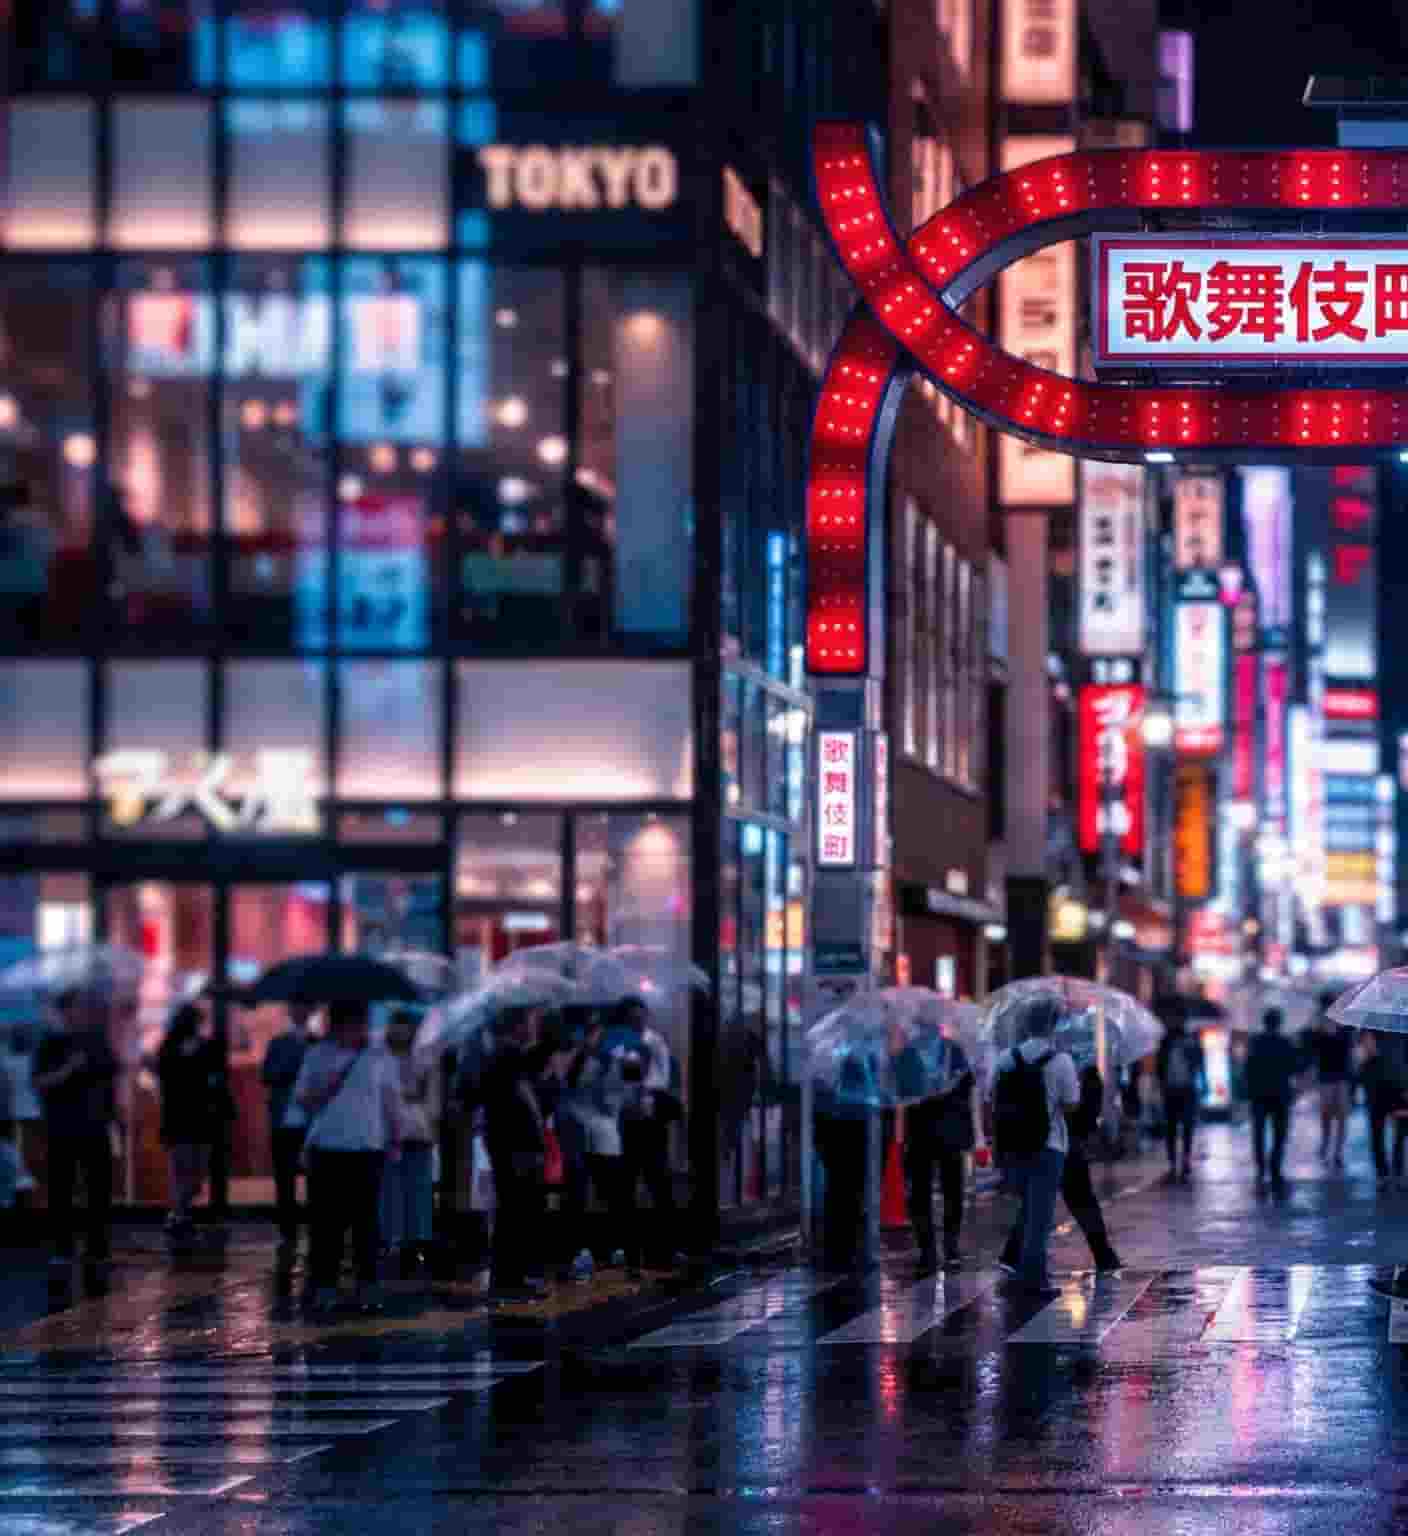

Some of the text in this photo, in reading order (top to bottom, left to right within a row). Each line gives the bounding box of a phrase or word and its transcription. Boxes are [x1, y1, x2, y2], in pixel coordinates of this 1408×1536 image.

[480, 144, 676, 209] TOKYO
[823, 738, 849, 859] 歌舞伎町
